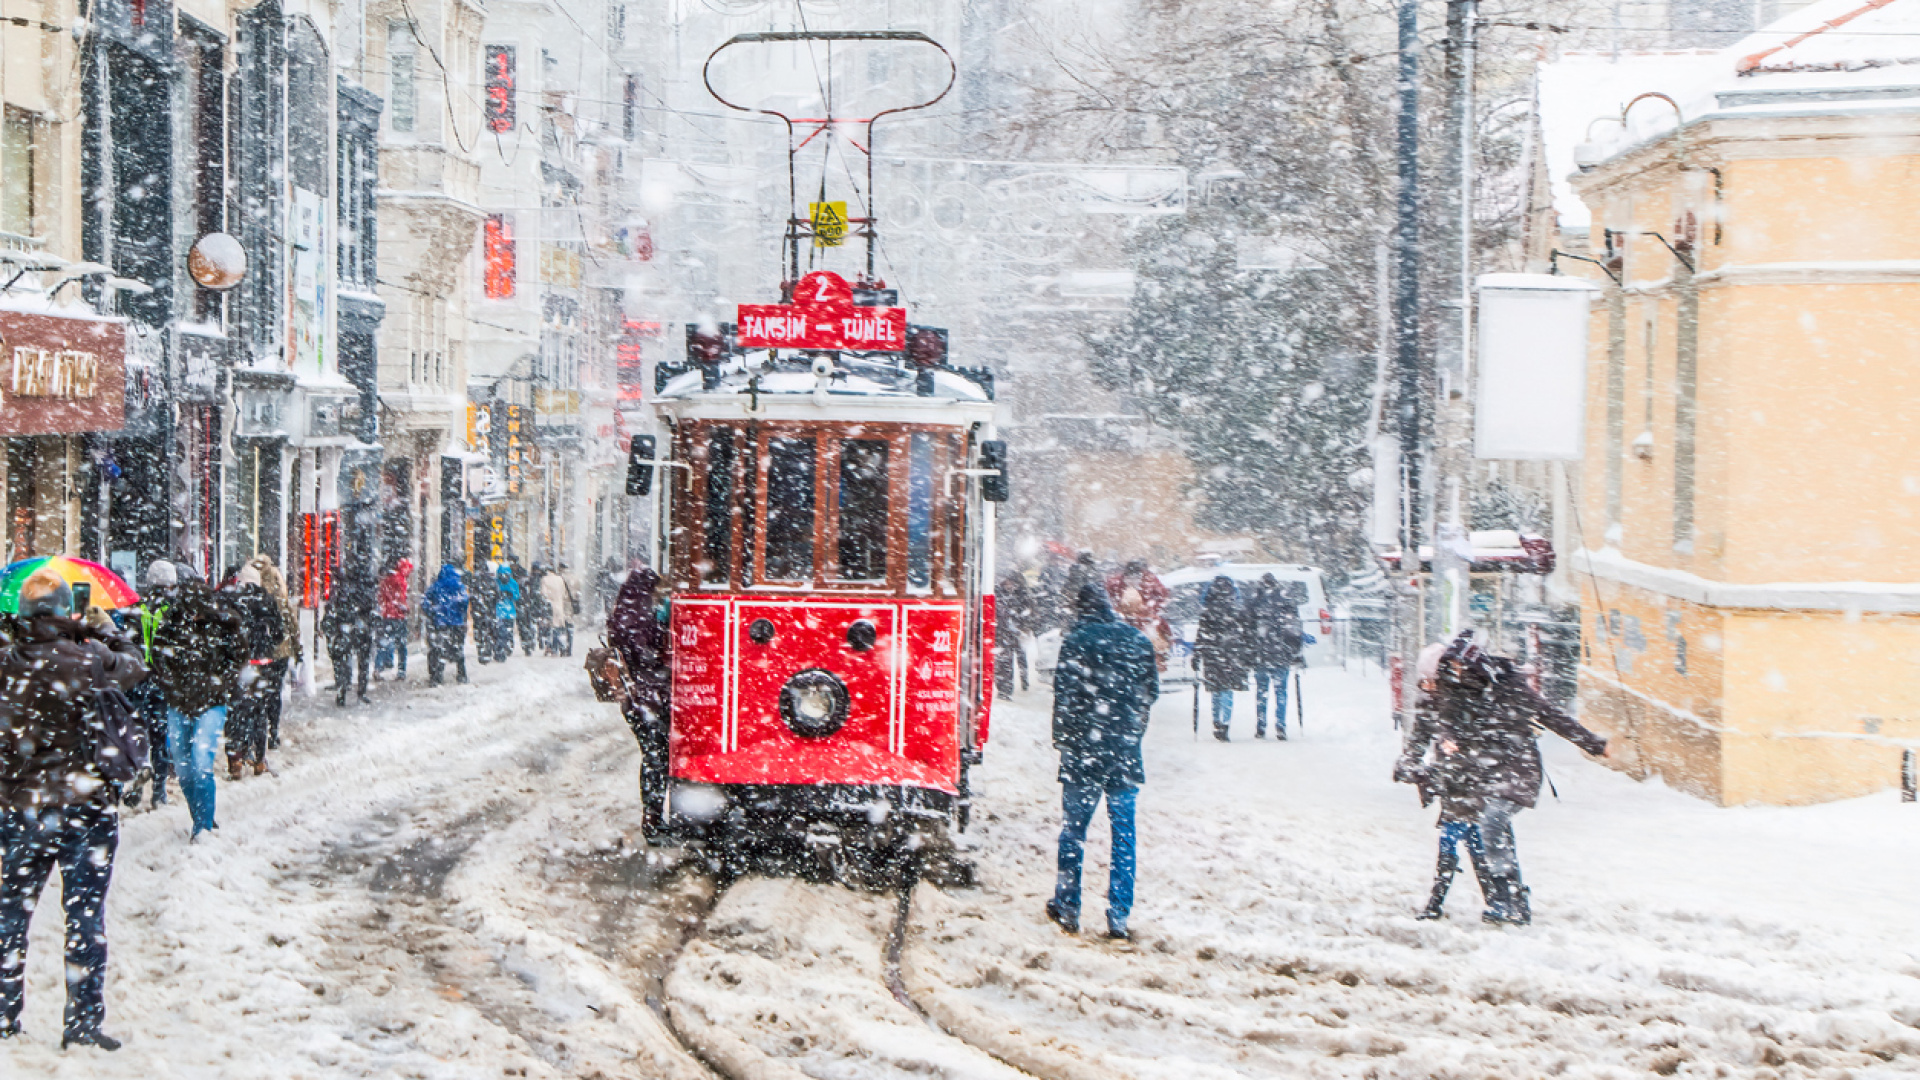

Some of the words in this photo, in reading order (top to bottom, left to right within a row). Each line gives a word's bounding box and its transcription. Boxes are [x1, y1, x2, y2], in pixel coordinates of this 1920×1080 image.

[815, 275, 828, 303] 2
[744, 311, 806, 340] TAKSİM
[841, 313, 897, 341] TÜNEL
